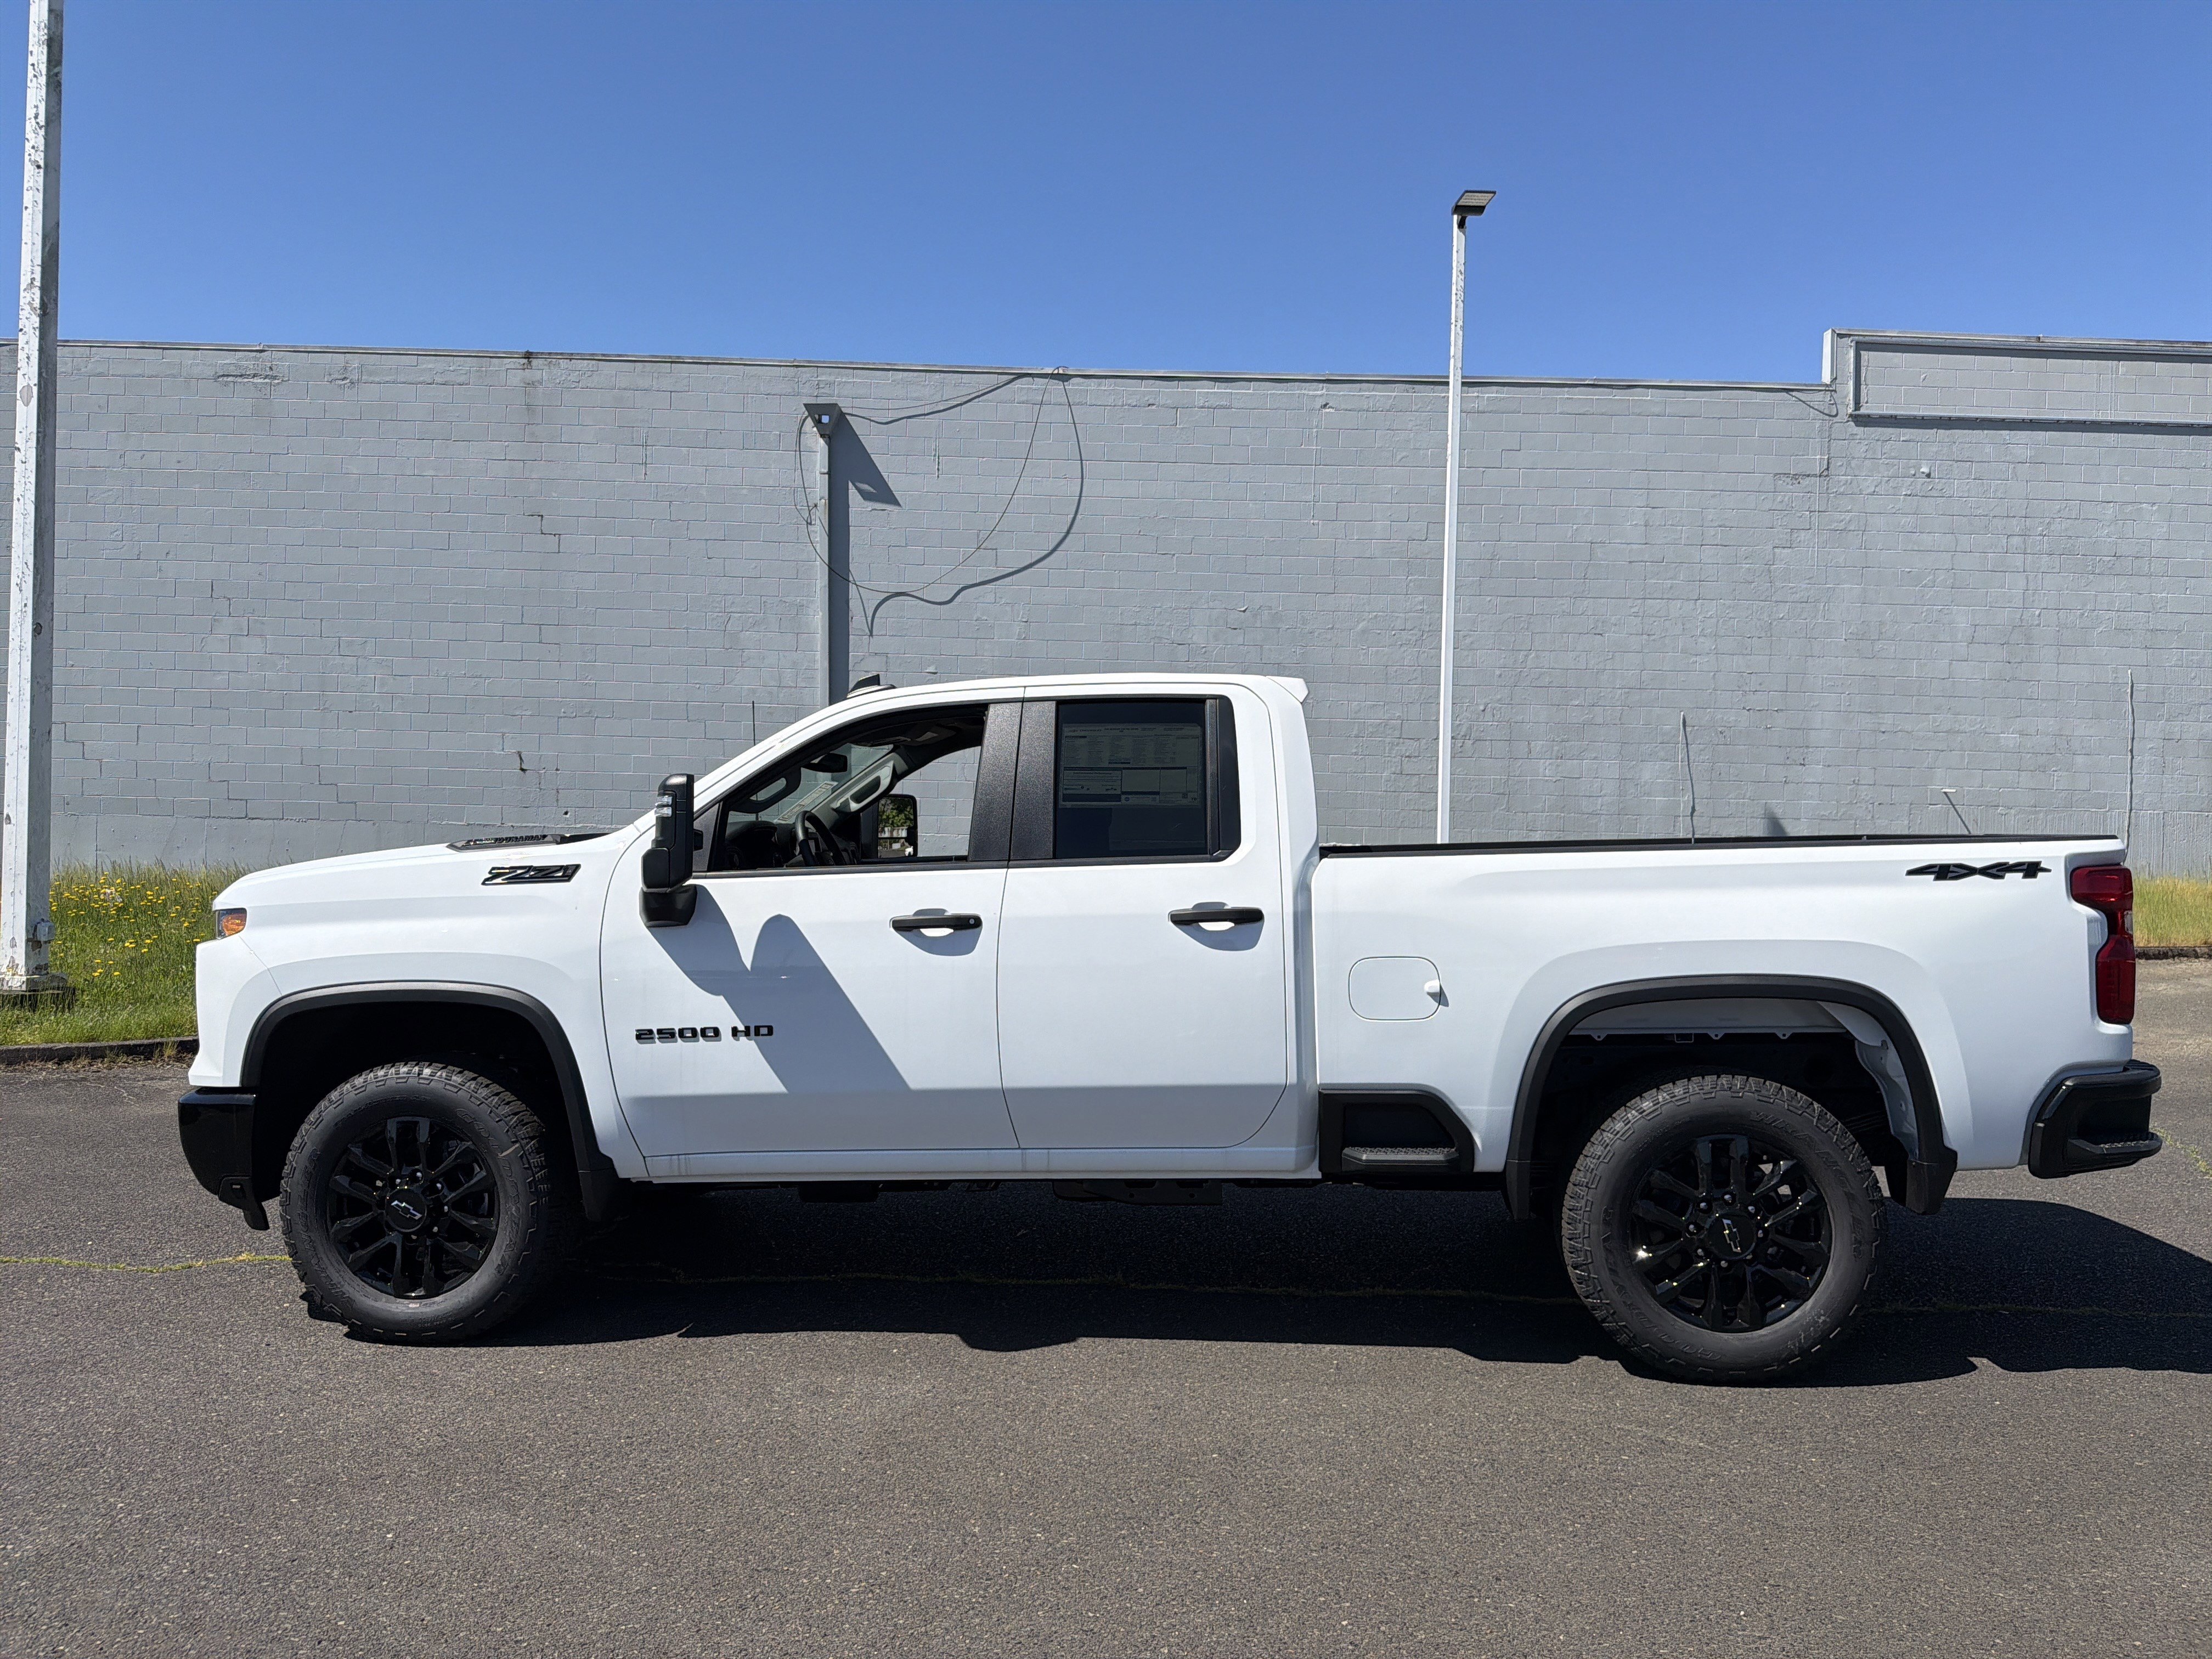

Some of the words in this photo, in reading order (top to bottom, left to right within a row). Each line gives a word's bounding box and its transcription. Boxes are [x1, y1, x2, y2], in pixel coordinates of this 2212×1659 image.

[481, 863, 581, 887] Z71
[635, 1026, 719, 1040] 2500
[731, 1025, 774, 1037] HD
